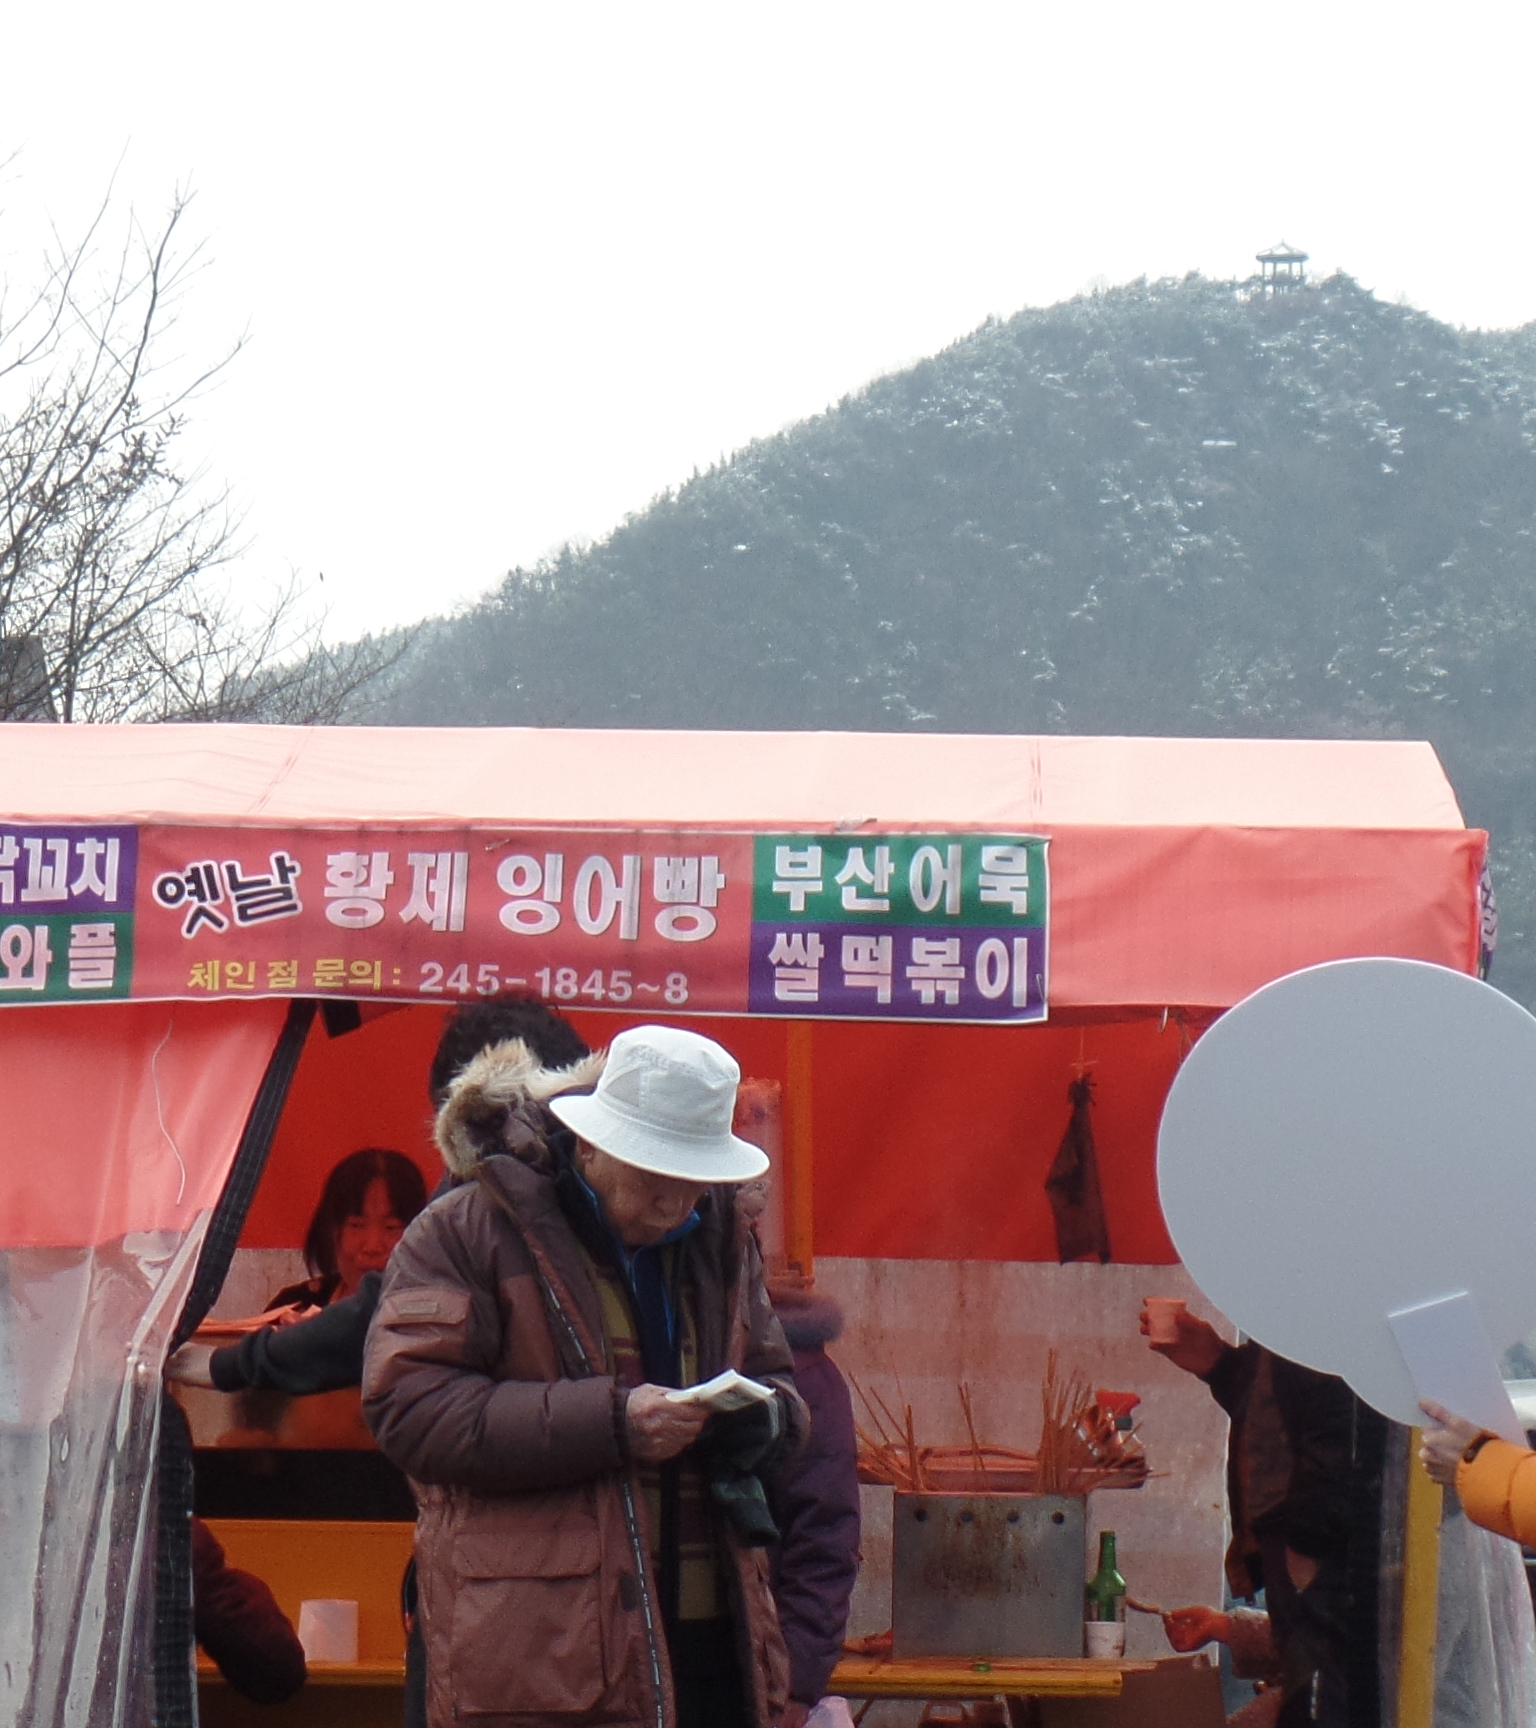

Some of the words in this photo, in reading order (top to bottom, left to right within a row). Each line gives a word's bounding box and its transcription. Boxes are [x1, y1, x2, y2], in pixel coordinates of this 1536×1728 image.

[154, 852, 300, 937] 옛날
[324, 850, 470, 932] 황제
[496, 852, 726, 943] 잉어빵
[772, 843, 1030, 916] 부산어묵
[187, 958, 299, 991] 체인점
[767, 931, 1029, 1008] 쌀떡볶이
